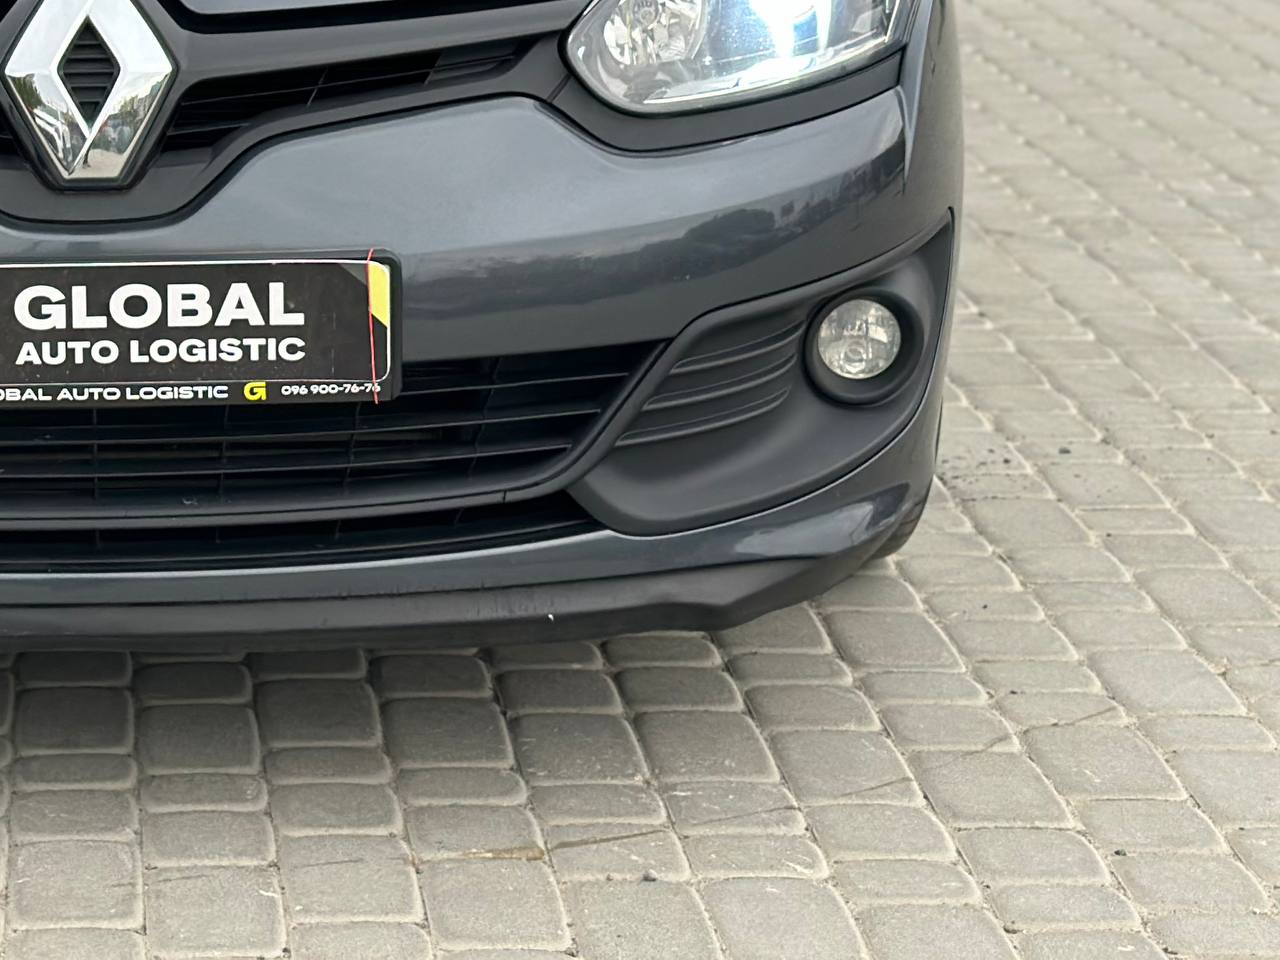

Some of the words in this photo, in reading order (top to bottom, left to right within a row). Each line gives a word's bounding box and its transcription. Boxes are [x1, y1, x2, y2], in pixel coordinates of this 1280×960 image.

[14, 281, 306, 330] GLOBAL
[15, 341, 119, 365] AUTO
[130, 337, 306, 364] LOGISTIC
[57, 387, 121, 400] AUTO
[126, 386, 228, 400] LOGISTIC
[281, 385, 308, 395] 096
